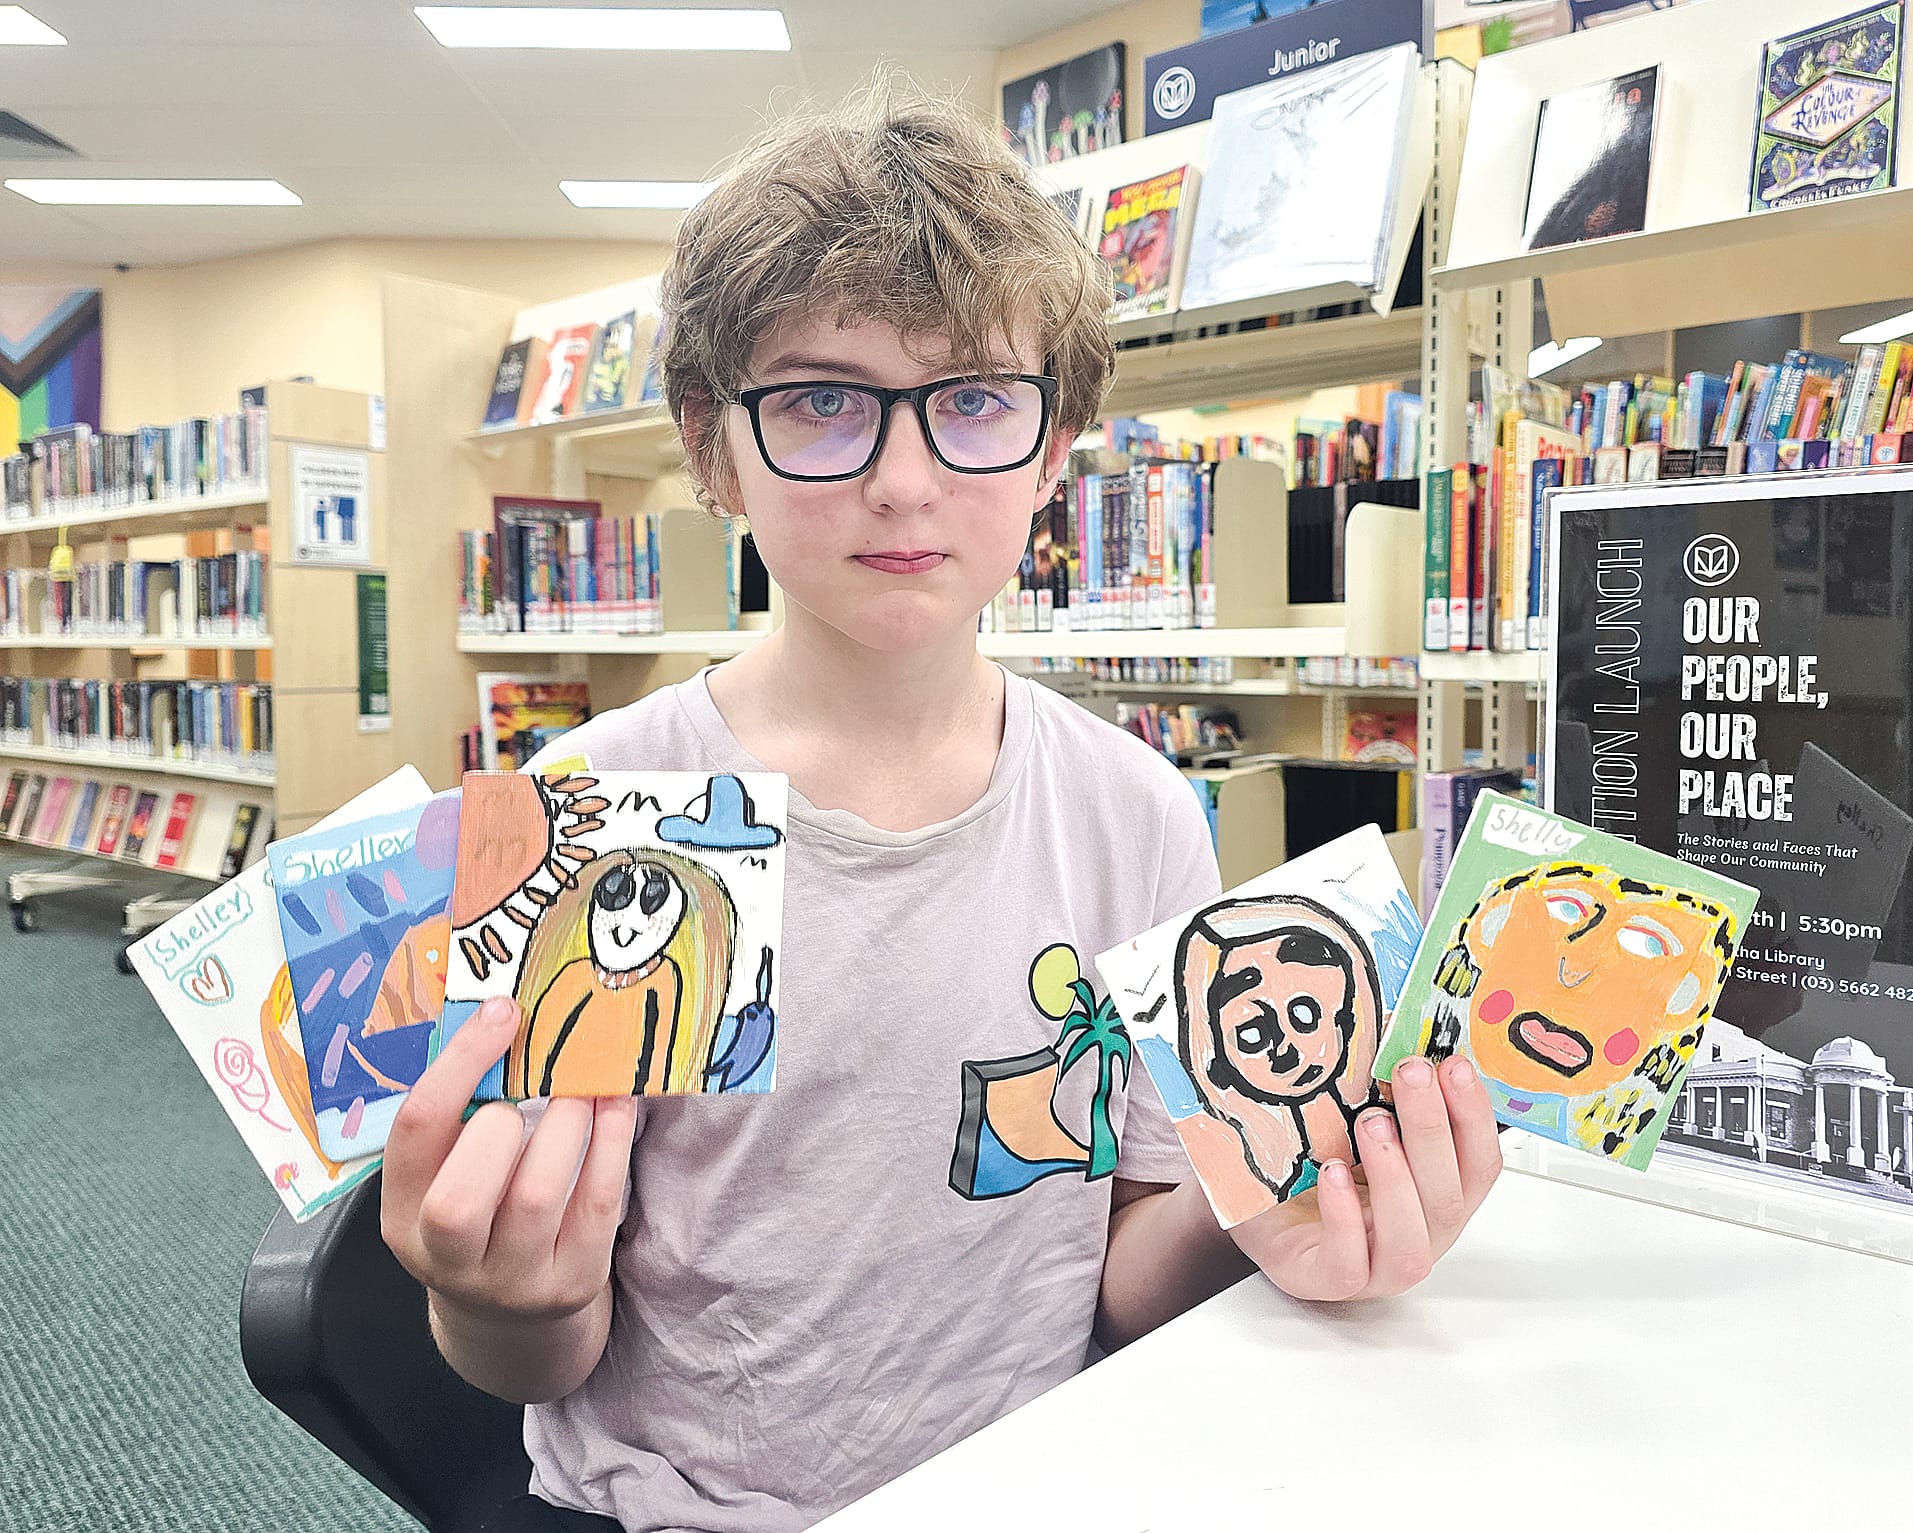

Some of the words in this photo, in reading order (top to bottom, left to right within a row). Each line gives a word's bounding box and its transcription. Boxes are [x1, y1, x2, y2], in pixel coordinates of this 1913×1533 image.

[1268, 37, 1341, 75] Junior
[1802, 88, 1854, 112] COLOUR
[1594, 539, 1643, 714] LAUNCH
[1682, 596, 1761, 644] OUR
[1681, 655, 1829, 709] PEOPLE,
[1679, 711, 1757, 761] OUR
[1678, 769, 1795, 822] PLACE
[1491, 808, 1572, 854] Shelly
[1676, 832, 1700, 846] The
[1702, 834, 1749, 850] Stories
[1752, 839, 1779, 852] and
[1782, 841, 1821, 856] Faces
[1825, 844, 1859, 859] That
[1676, 849, 1717, 866] Shape
[1720, 853, 1747, 866] Our
[1749, 855, 1827, 878] Community
[155, 889, 243, 962] Shelley
[1751, 910, 1774, 928] th
[1799, 915, 1882, 940] 5:30pm
[1764, 948, 1825, 971] Library
[1736, 967, 1787, 985] Street
[1800, 975, 1835, 993] (03)
[1839, 979, 1880, 997] 5662
